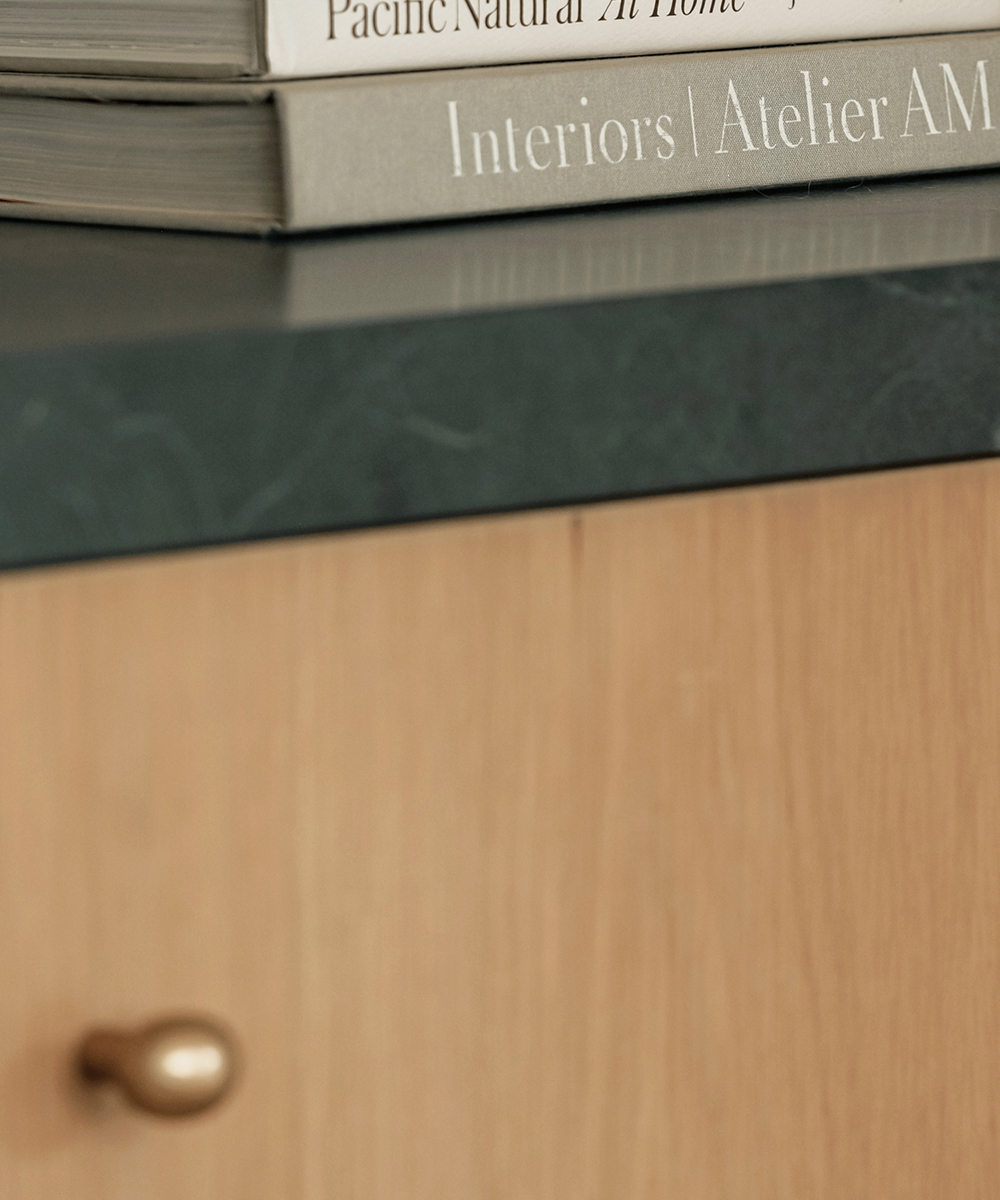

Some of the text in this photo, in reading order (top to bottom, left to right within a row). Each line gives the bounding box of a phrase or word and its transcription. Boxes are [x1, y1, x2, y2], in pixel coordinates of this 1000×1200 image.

[447, 96, 676, 177] Interiors
[714, 68, 888, 154] Atelier
[899, 59, 997, 138] AM
